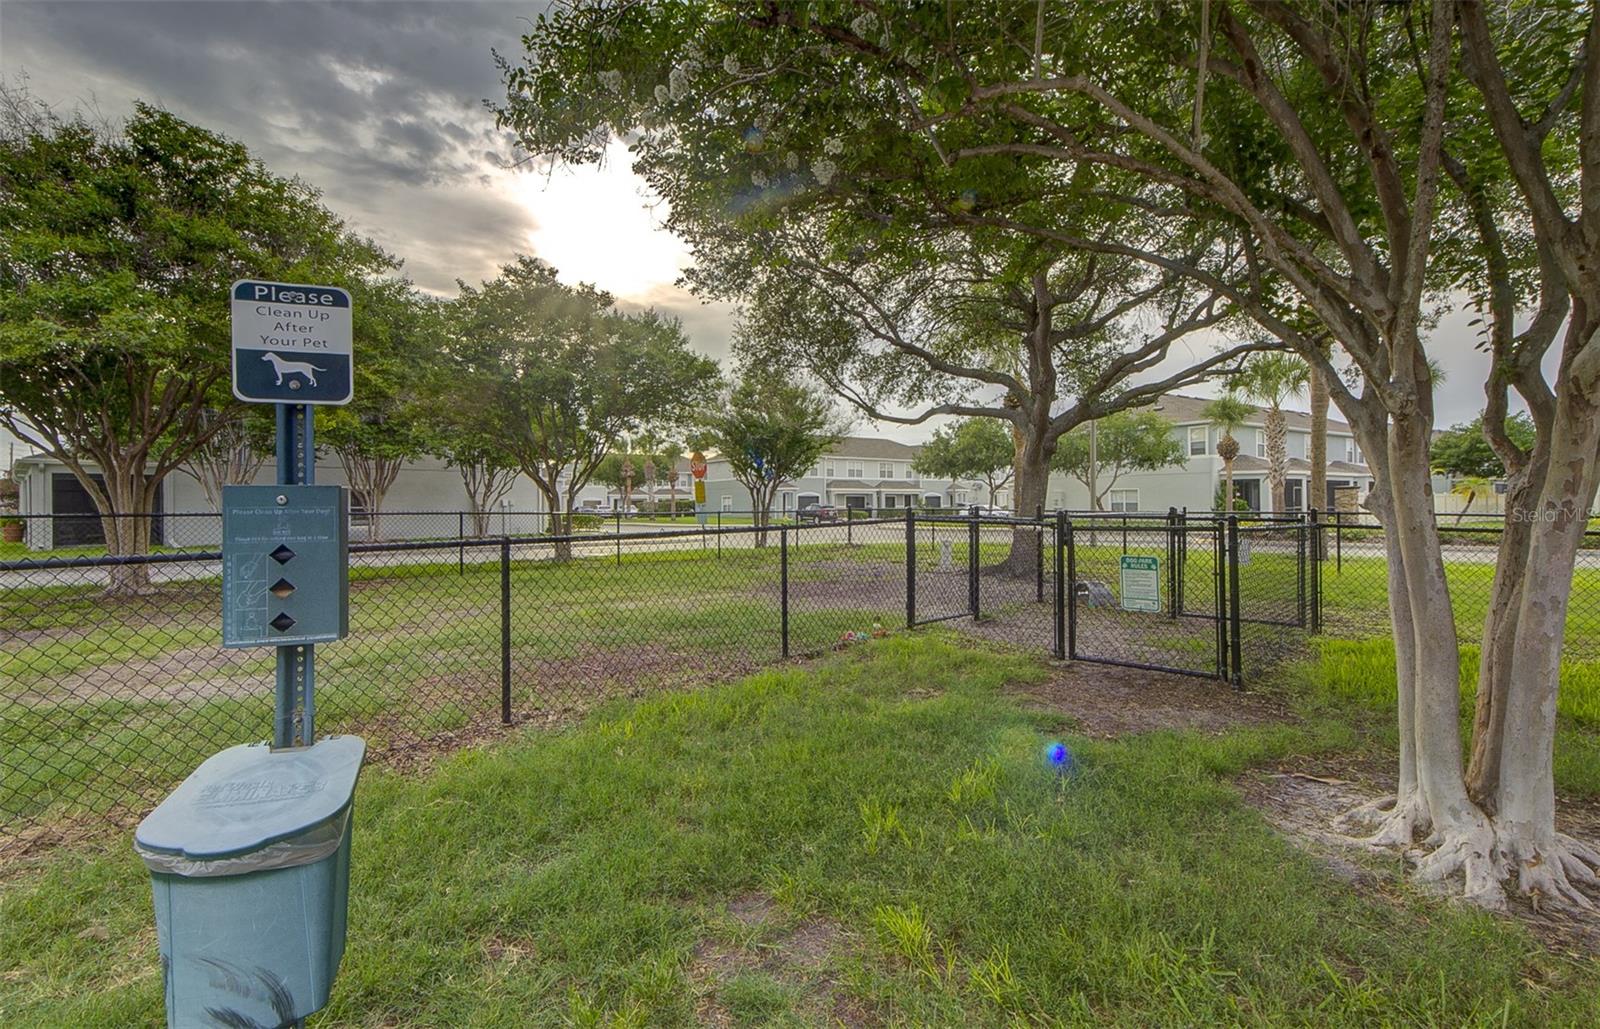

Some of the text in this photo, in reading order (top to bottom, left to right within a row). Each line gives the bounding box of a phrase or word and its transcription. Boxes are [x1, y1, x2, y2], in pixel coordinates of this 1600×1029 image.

[254, 285, 334, 305] Please
[255, 305, 330, 321] Clean Up
[273, 321, 314, 333] After
[260, 335, 328, 348] Your Pet
[691, 461, 706, 471] STOP
